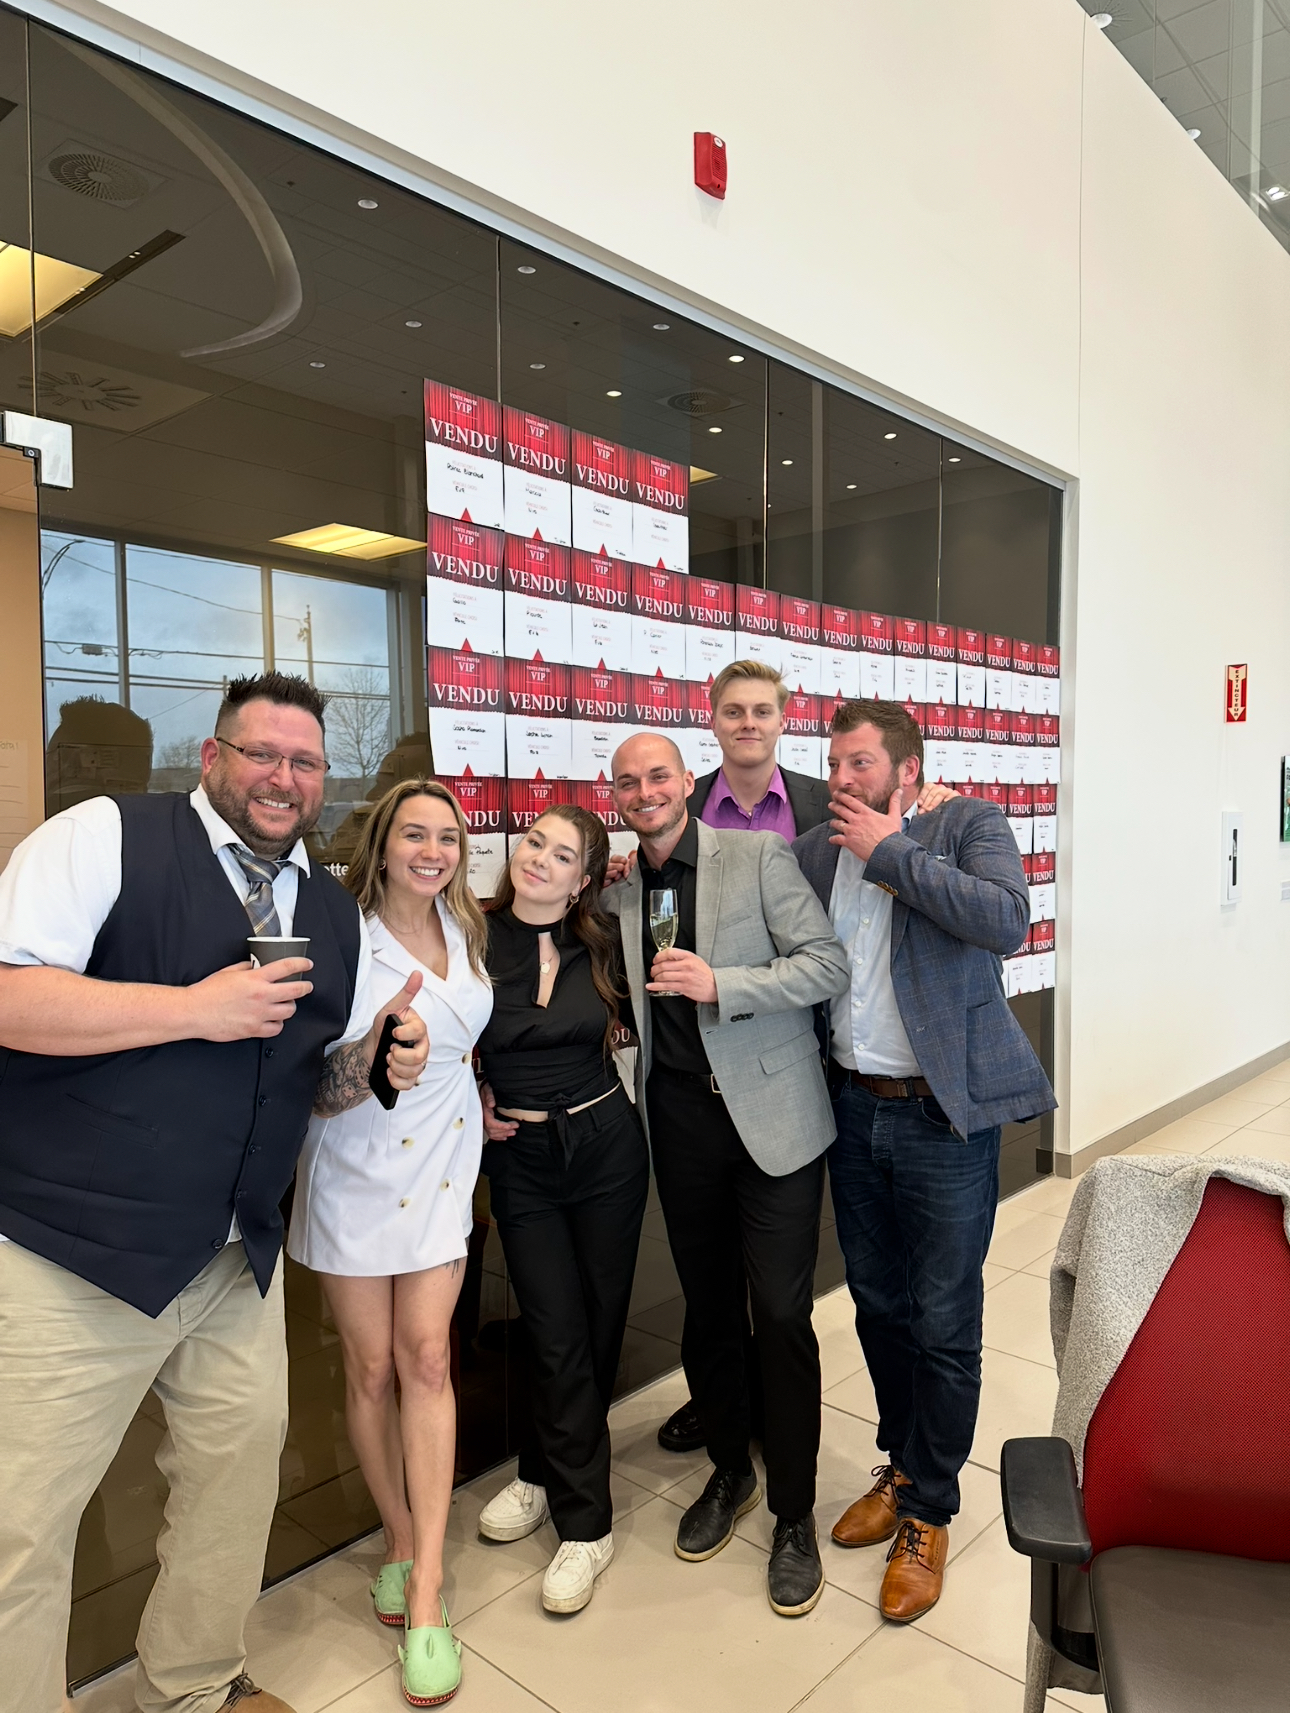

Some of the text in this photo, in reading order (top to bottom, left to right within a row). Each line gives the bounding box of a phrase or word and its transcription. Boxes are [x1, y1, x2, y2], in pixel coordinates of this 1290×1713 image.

[455, 401, 472, 414] VIP
[429, 416, 498, 453] VENDU
[530, 425, 544, 438] VIP
[507, 441, 566, 475] VENDU
[597, 447, 611, 460] VIP
[576, 463, 629, 494] VENDU
[654, 466, 668, 478] VIP
[636, 481, 685, 510] VENDU
[457, 533, 475, 546] VIP
[530, 550, 545, 562] VIP
[431, 551, 499, 583] VENDU
[595, 564, 609, 575] VIP
[508, 567, 567, 596] VENDU
[653, 578, 666, 588] VIP
[575, 581, 628, 607] VENDU
[704, 588, 716, 598] VIP
[635, 594, 683, 618] VENDU
[753, 596, 764, 606] VIP
[688, 604, 732, 626] VENDU
[796, 606, 806, 615] VIP
[738, 612, 778, 632] VENDU
[782, 621, 819, 640] VENDU
[824, 629, 857, 647] VENDU
[862, 634, 893, 651] VENDU
[897, 639, 925, 655] VENDU
[928, 643, 955, 658] VENDU
[958, 648, 984, 663] VENDU
[987, 653, 1011, 668] VENDU
[458, 661, 475, 673] VIP
[1013, 658, 1036, 673] VENDU
[1037, 662, 1059, 675] VENDU
[531, 671, 546, 681] VIP
[595, 679, 609, 689] VIP
[652, 686, 665, 695] VIP
[433, 683, 500, 706] VENDU
[508, 691, 568, 713] VENDU
[575, 697, 628, 718] VENDU
[796, 700, 806, 708] VIP
[634, 703, 683, 723] VENDU
[688, 708, 713, 724] VEN
[784, 717, 819, 732] VENDU
[928, 724, 955, 737] VENDU
[958, 726, 983, 738] VENDU
[985, 729, 1010, 741] VENDU
[1011, 731, 1035, 743] VENDU
[1036, 733, 1059, 744] VENDU
[460, 787, 477, 797] VIP
[533, 789, 548, 799] VIP
[596, 790, 610, 799] VIP
[1009, 803, 1032, 814] VENDU
[1034, 802, 1056, 813] VENDU
[464, 810, 500, 827] NDU
[324, 862, 349, 876] tte
[1032, 870, 1054, 882] VENDU
[1033, 938, 1054, 951] VENDU
